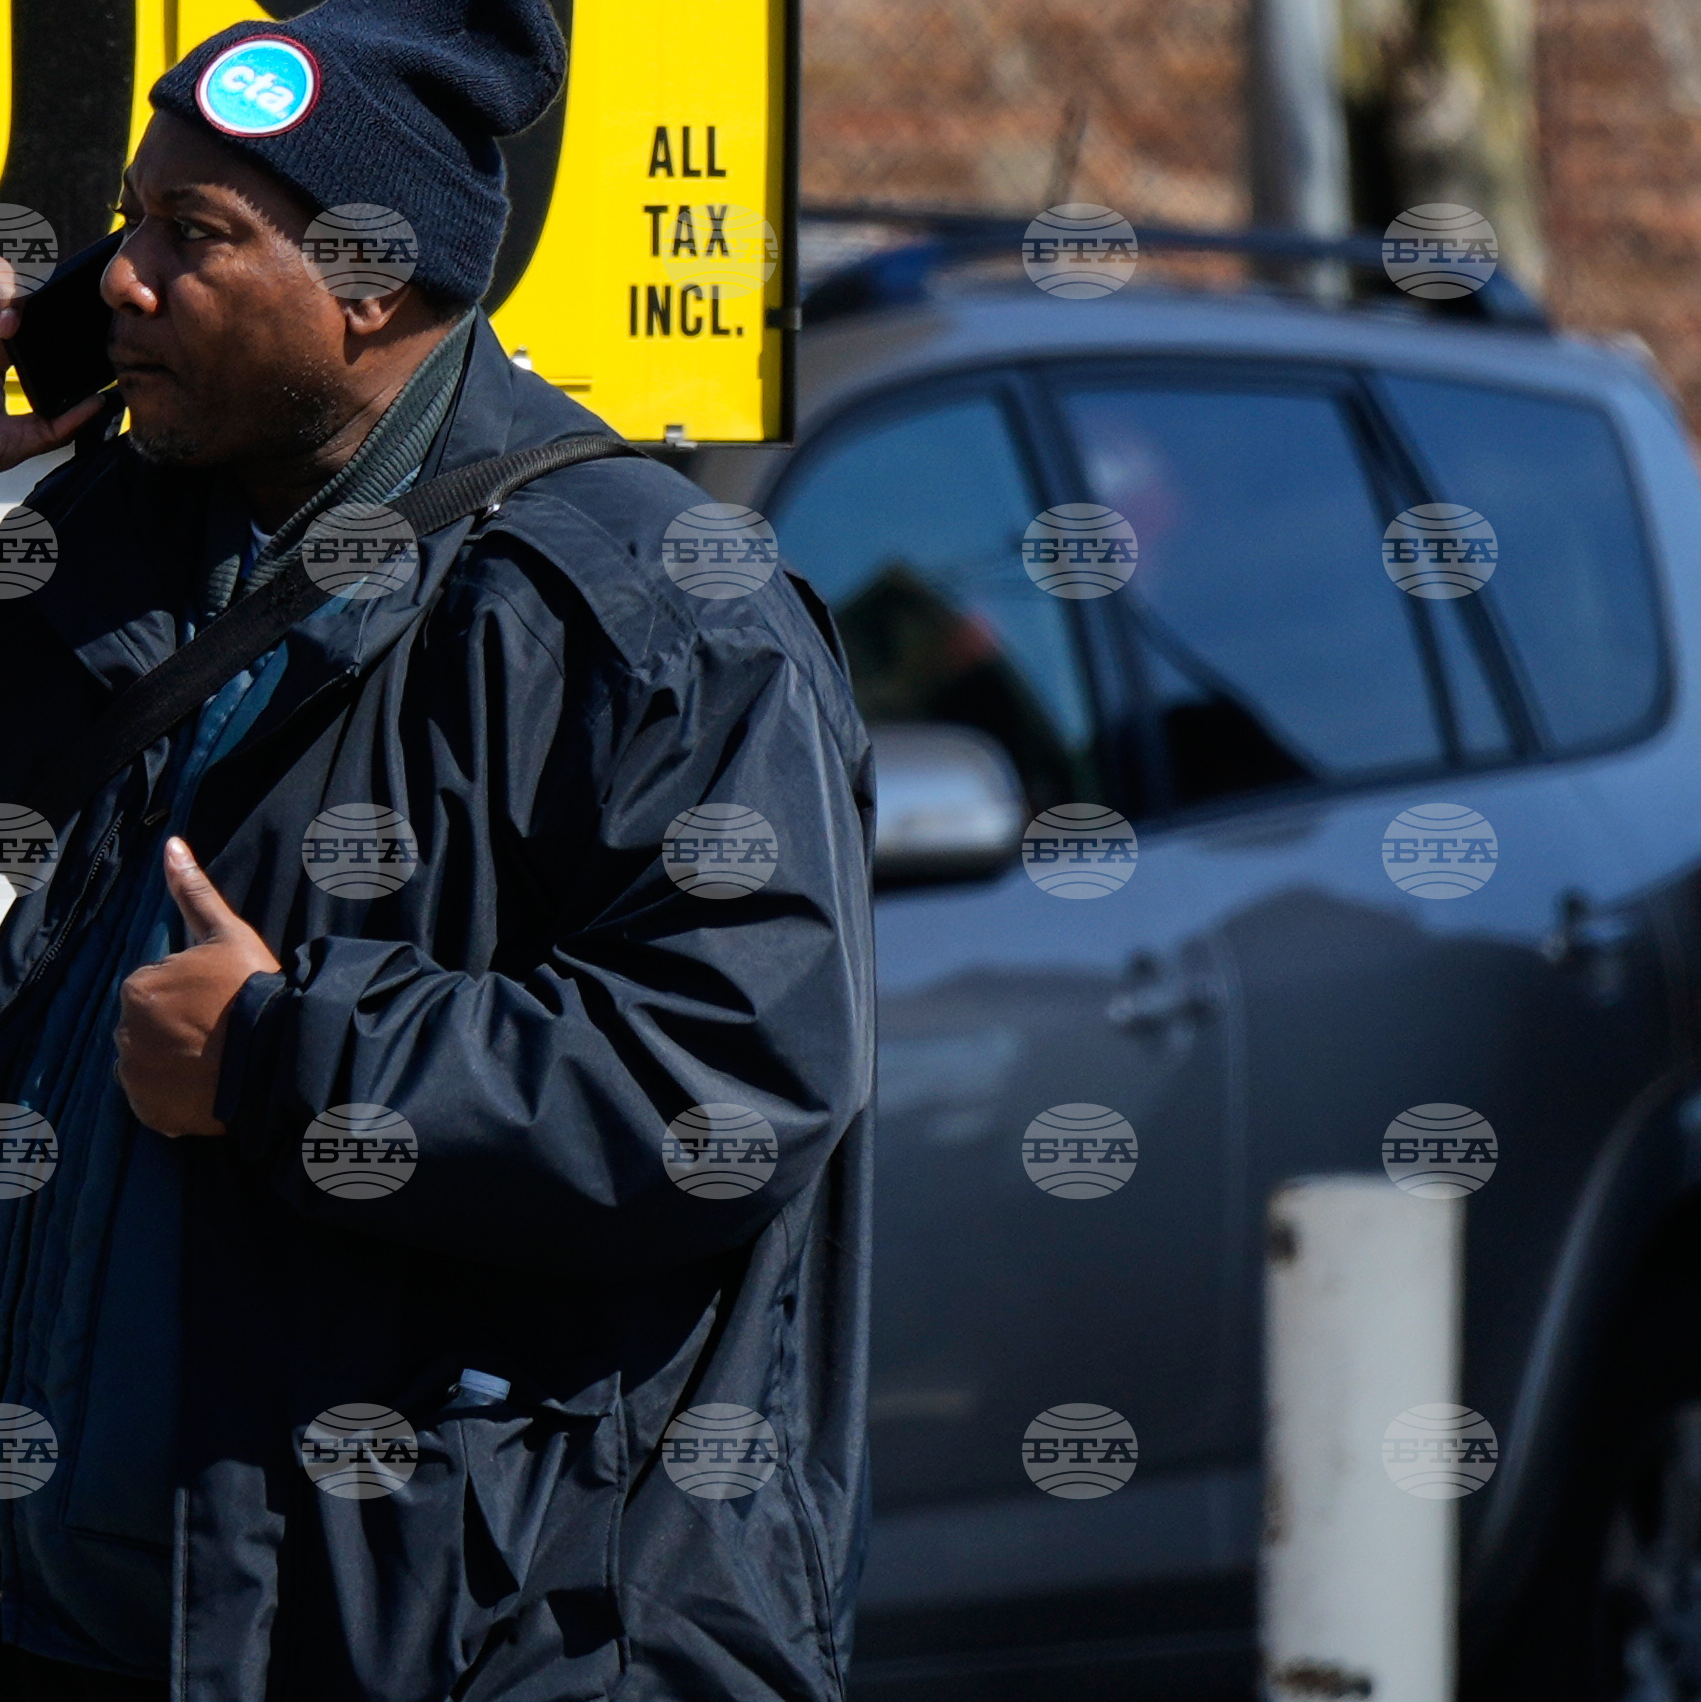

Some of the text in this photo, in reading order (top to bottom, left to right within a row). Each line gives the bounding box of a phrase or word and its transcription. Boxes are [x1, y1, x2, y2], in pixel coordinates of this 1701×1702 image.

[221, 64, 296, 114] cta
[647, 125, 727, 179] ALL
[643, 204, 731, 258] TAX
[628, 284, 745, 338] INCL.
